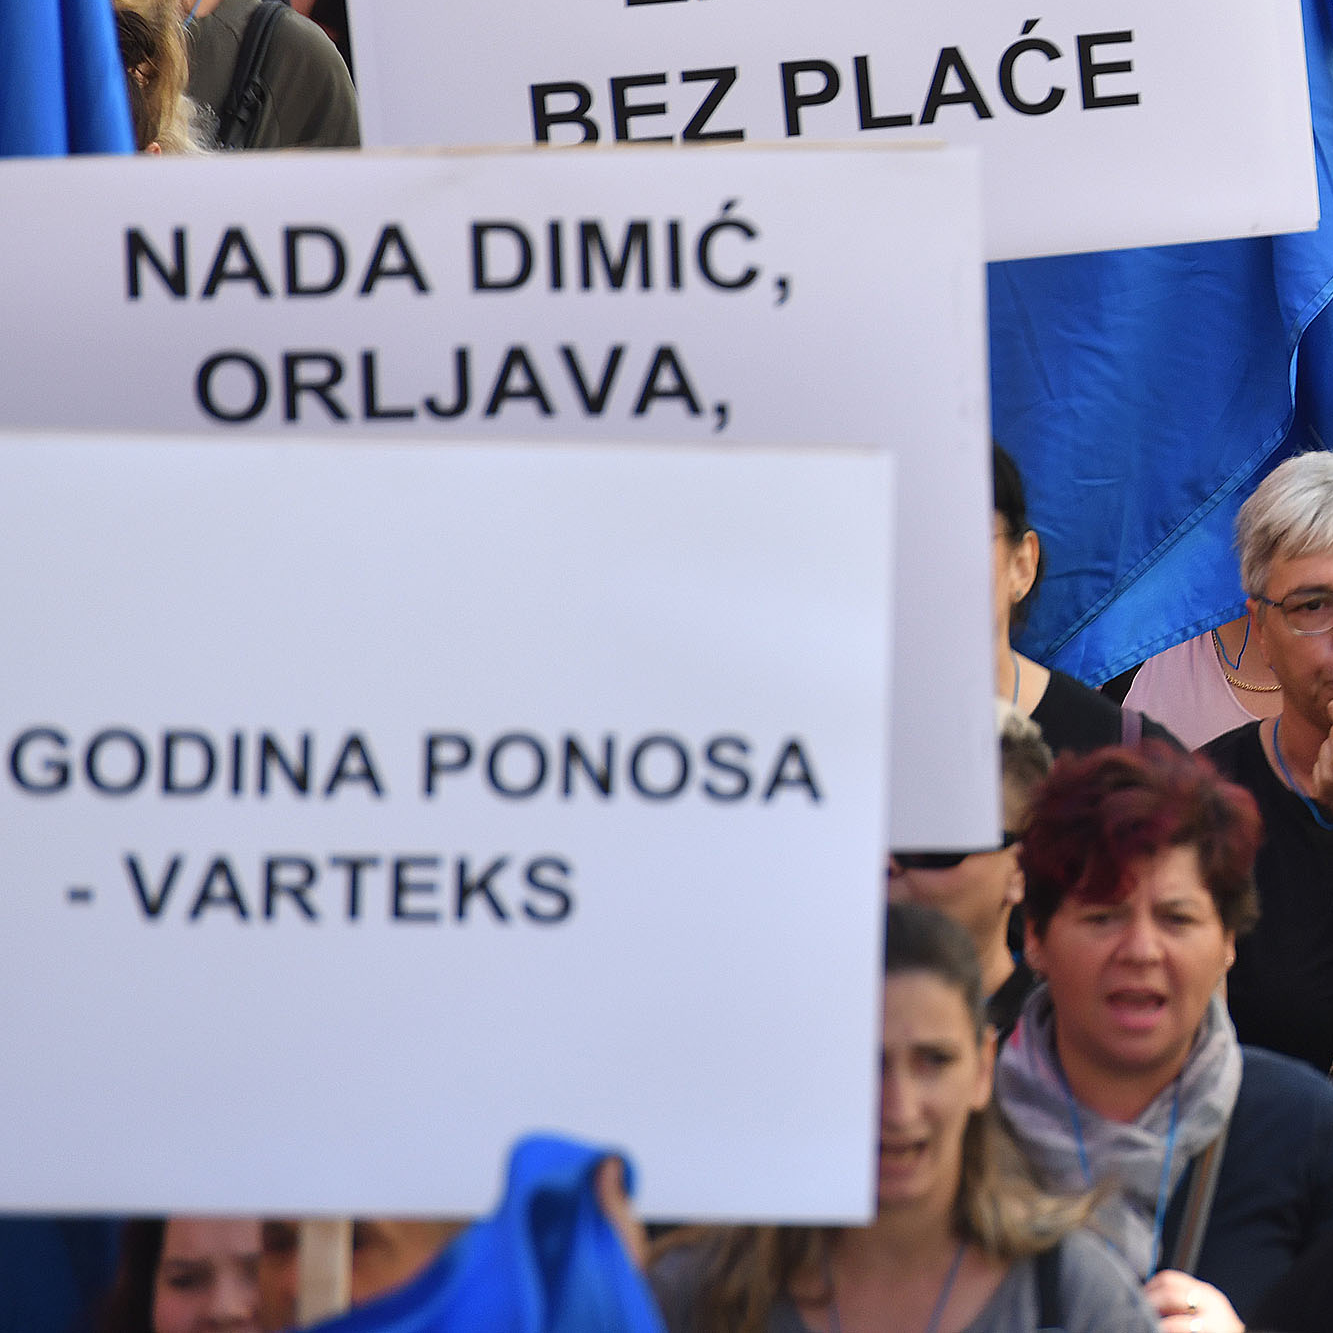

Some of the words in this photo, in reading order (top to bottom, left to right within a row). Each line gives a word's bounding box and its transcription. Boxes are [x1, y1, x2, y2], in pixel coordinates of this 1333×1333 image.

[528, 65, 747, 147] BEZ
[778, 18, 1142, 138] PLAĆE
[122, 223, 432, 302] NADA
[468, 198, 792, 306] DIMIĆ,
[192, 343, 731, 431] ORLJAVA,
[6, 726, 386, 798] GODINA
[421, 732, 823, 803] PONOSA
[66, 886, 94, 905] -
[123, 853, 576, 925] VARTEKS
